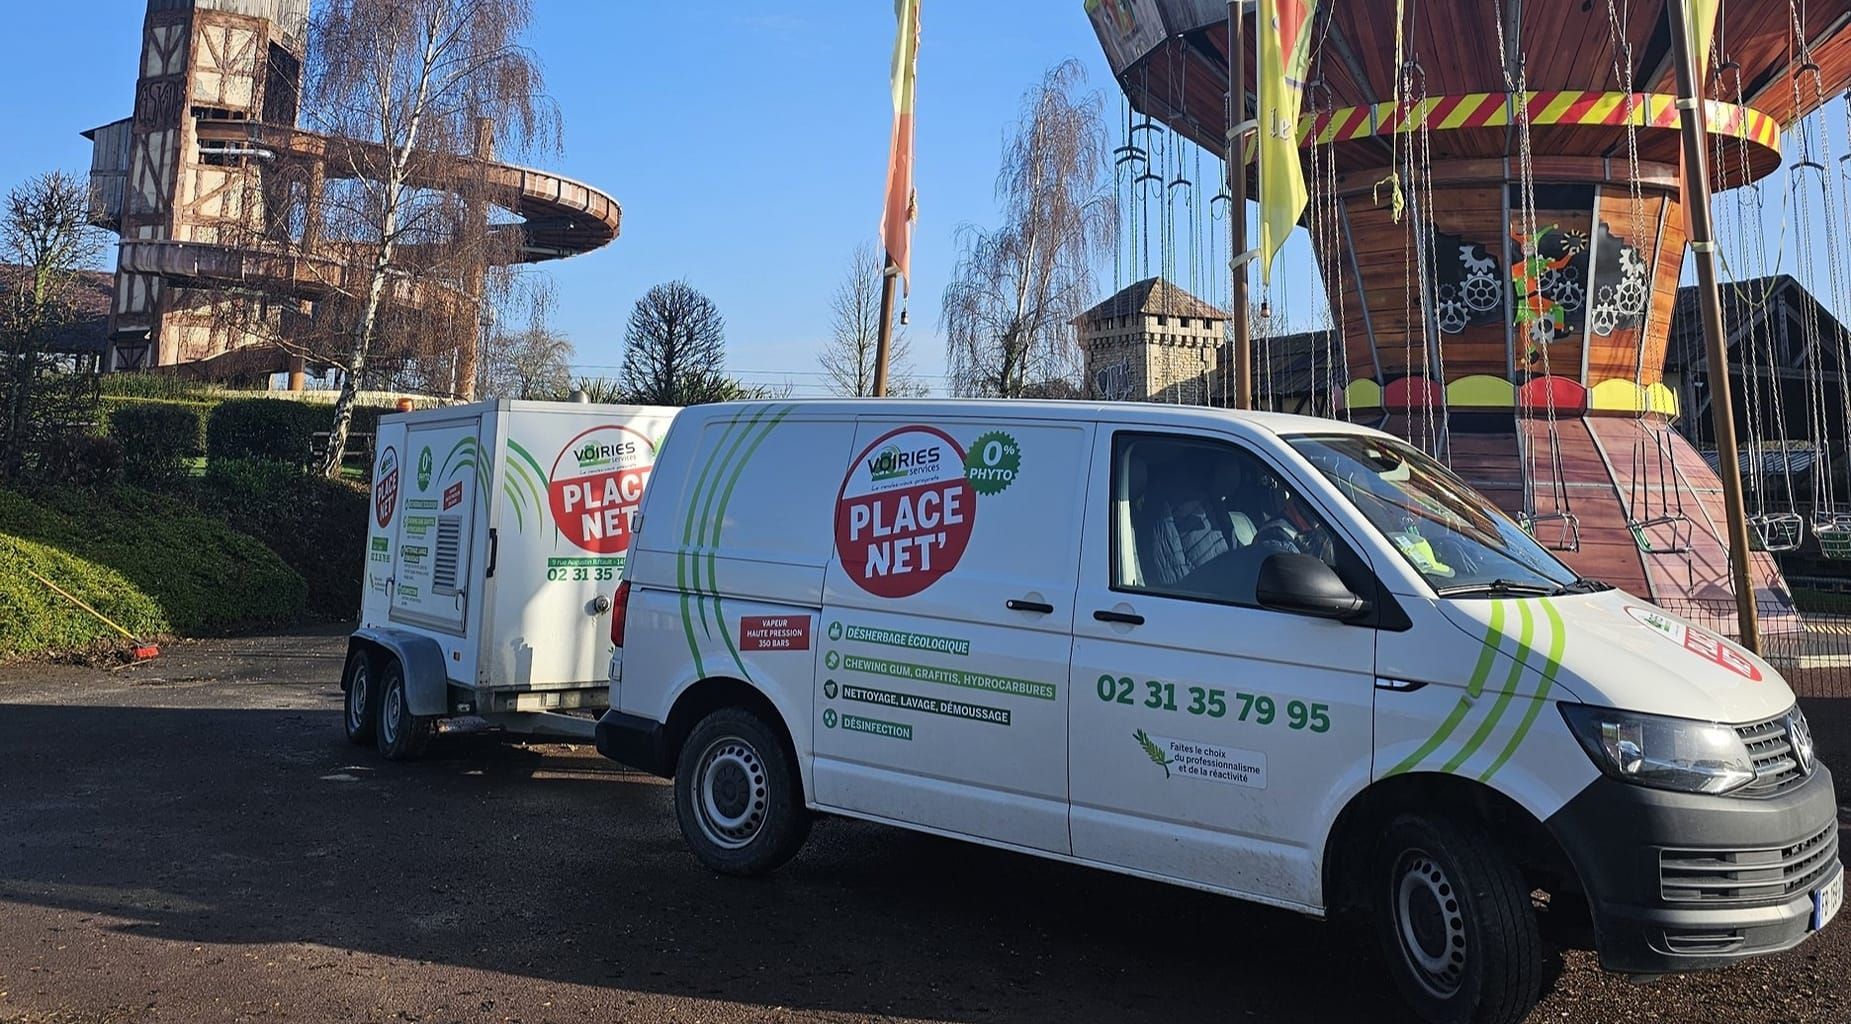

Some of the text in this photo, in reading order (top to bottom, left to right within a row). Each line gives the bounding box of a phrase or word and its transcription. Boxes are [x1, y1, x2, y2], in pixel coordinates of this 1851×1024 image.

[573, 441, 636, 462] VOIRIES
[867, 446, 940, 475] VOIRIES
[983, 440, 1015, 466] 0%
[909, 463, 940, 476] services
[969, 467, 1013, 481] PHYTO
[849, 485, 964, 542] PLACE
[864, 531, 946, 579] NET'
[547, 568, 568, 581] 02
[572, 568, 589, 581] 31
[594, 568, 613, 581] 35
[746, 628, 803, 638] HAUTE PRESSION
[762, 619, 788, 628] VAPEUR
[759, 639, 790, 648] 350 BARS
[847, 626, 969, 654] DÉSHERBAGE ÉCOLOGIQUE
[845, 657, 1053, 697] CHEWING GUM, GRAFITIS, HYDROCARBURES
[844, 687, 1009, 723] NETTOYAGE, LAVAGE, DÉMOUSSAGE
[1096, 674, 1331, 733] 02 31 35 79 95
[844, 716, 910, 738] DÉSINFECTION
[1170, 741, 1226, 758] Faites le choix
[1174, 753, 1261, 774] du professionnalisme
[1178, 764, 1248, 783] et de la réactivité
